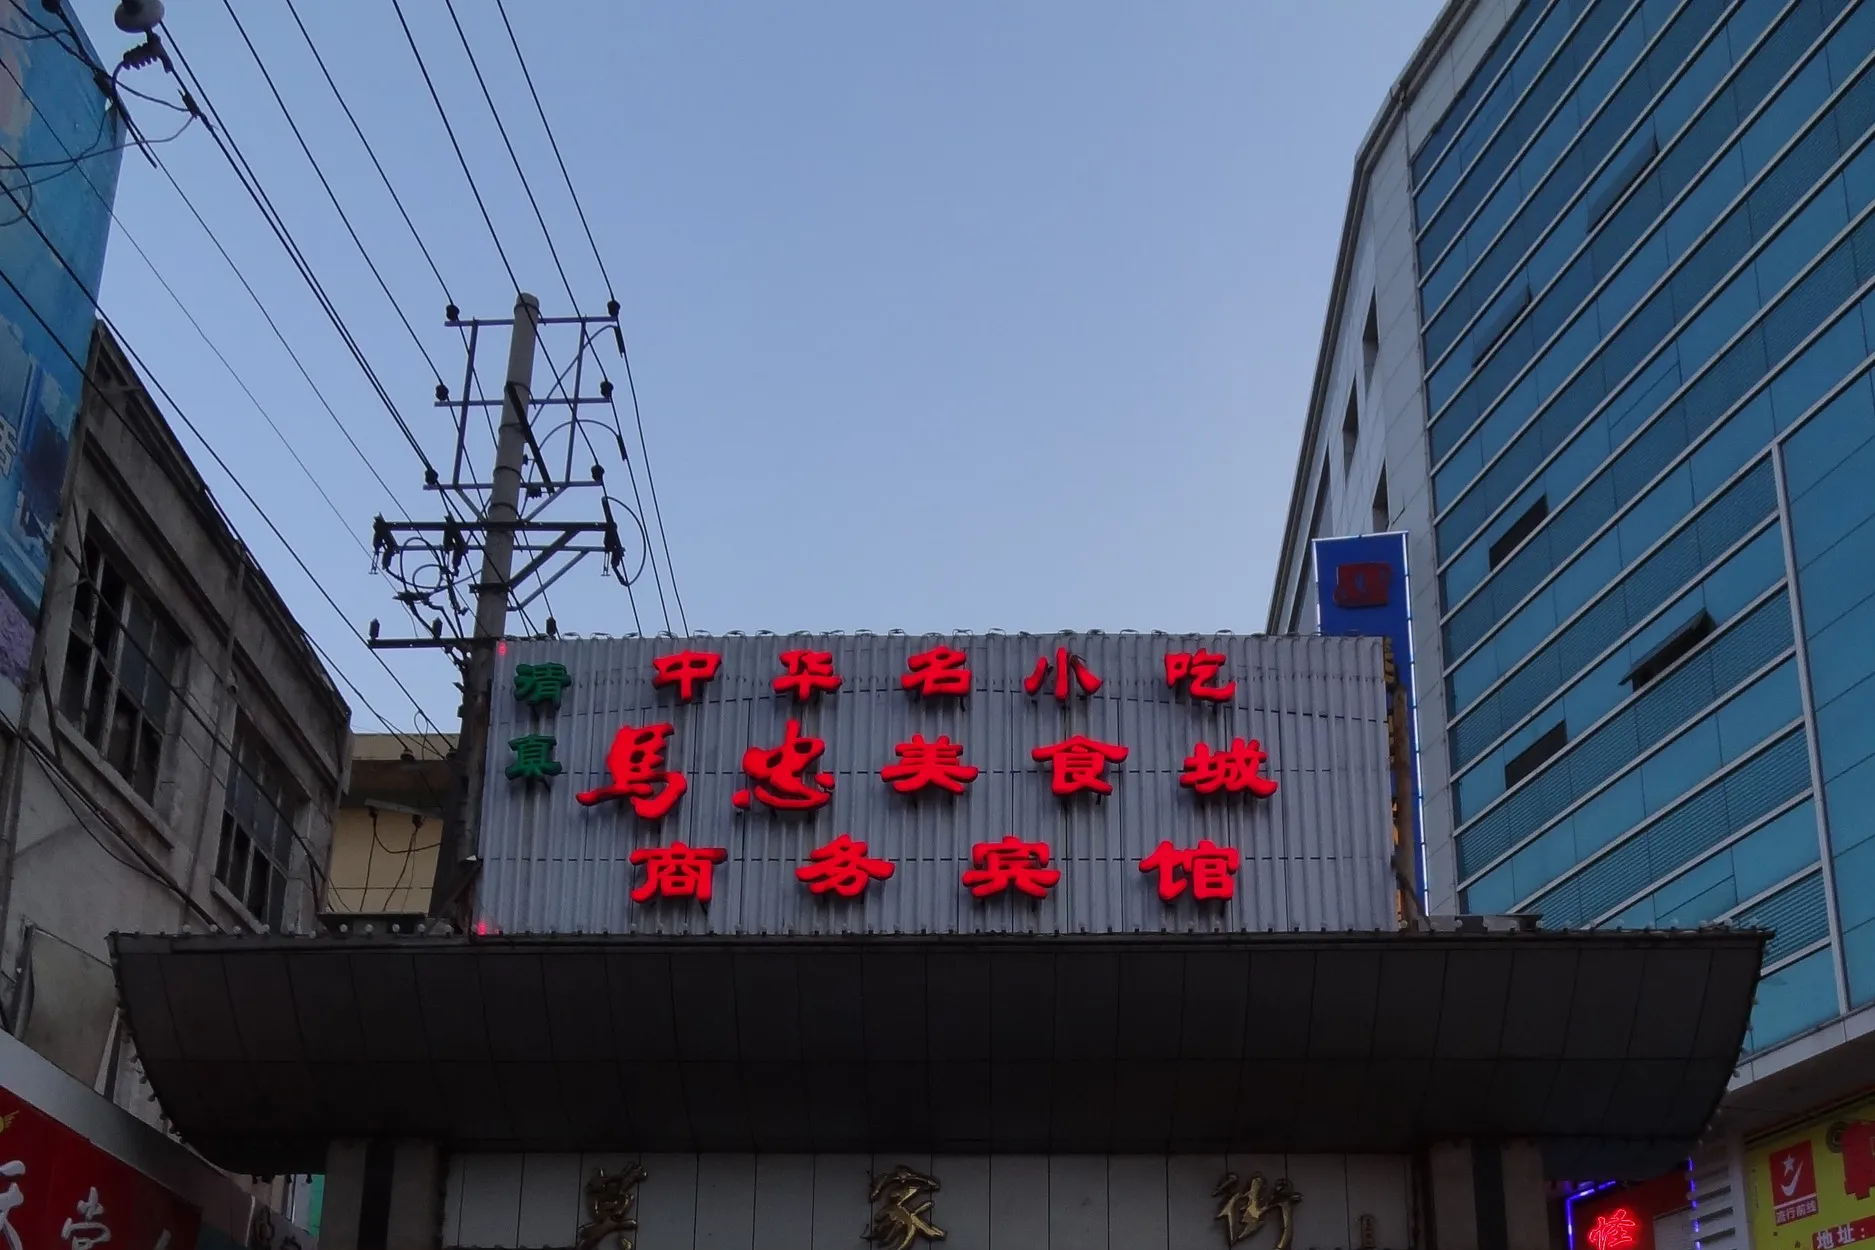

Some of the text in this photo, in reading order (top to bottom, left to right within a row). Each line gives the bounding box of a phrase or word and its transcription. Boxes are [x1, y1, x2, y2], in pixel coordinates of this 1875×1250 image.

[652, 645, 1238, 705] 中华名小吃
[504, 661, 572, 782] 清真
[629, 833, 1241, 904] 商务宾馆
